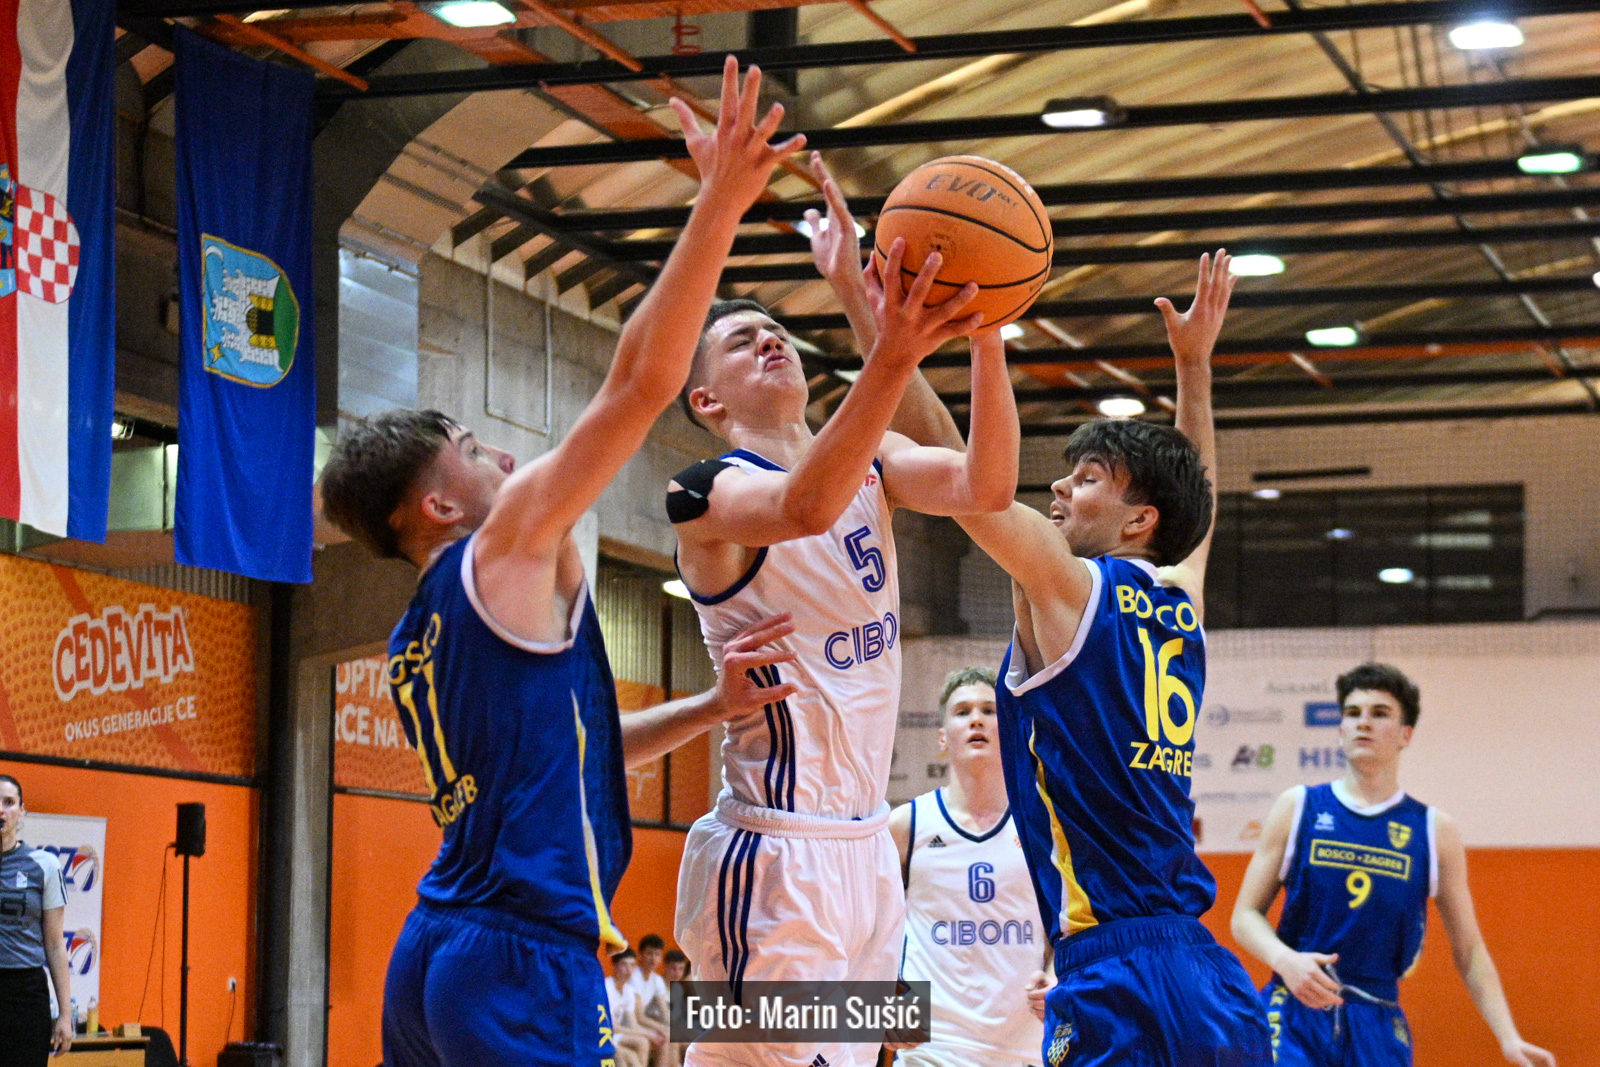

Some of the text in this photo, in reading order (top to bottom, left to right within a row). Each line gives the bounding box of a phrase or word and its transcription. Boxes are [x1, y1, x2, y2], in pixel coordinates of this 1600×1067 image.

[924, 172, 999, 203] EVO
[843, 525, 886, 592] 5
[53, 604, 194, 700] CEDEVITA
[825, 612, 897, 670] CIBO
[1138, 626, 1195, 746] 16
[65, 696, 197, 742] OKUS GENERACIJE CE
[374, 716, 399, 748] NA
[1317, 848, 1356, 862] BOSCO
[967, 861, 996, 904] 6
[1346, 870, 1372, 909] 9
[931, 919, 1034, 946] CIBONA
